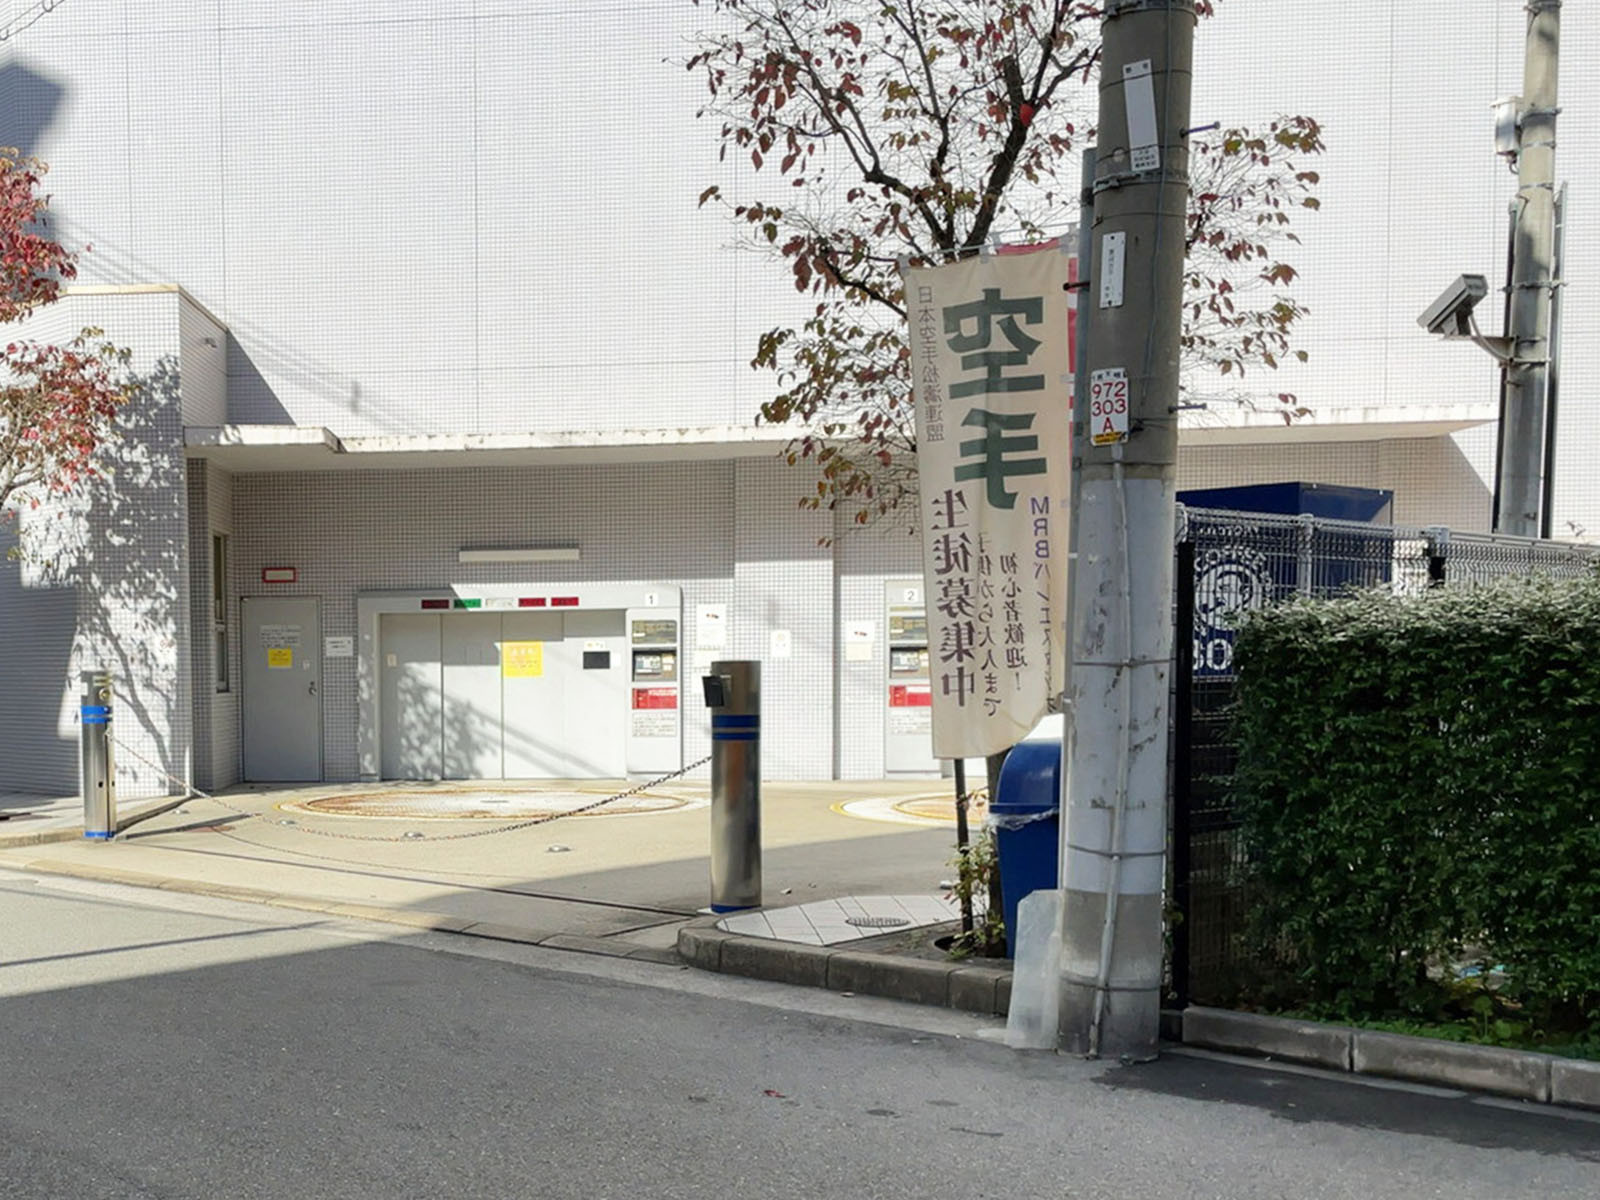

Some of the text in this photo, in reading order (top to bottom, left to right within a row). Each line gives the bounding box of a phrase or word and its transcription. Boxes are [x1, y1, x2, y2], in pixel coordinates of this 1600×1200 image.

[1092, 381, 1126, 400] 972
[1092, 398, 1126, 417] 303
[1103, 416, 1114, 433] A
[649, 594, 654, 605] 1
[906, 590, 916, 601] 2
